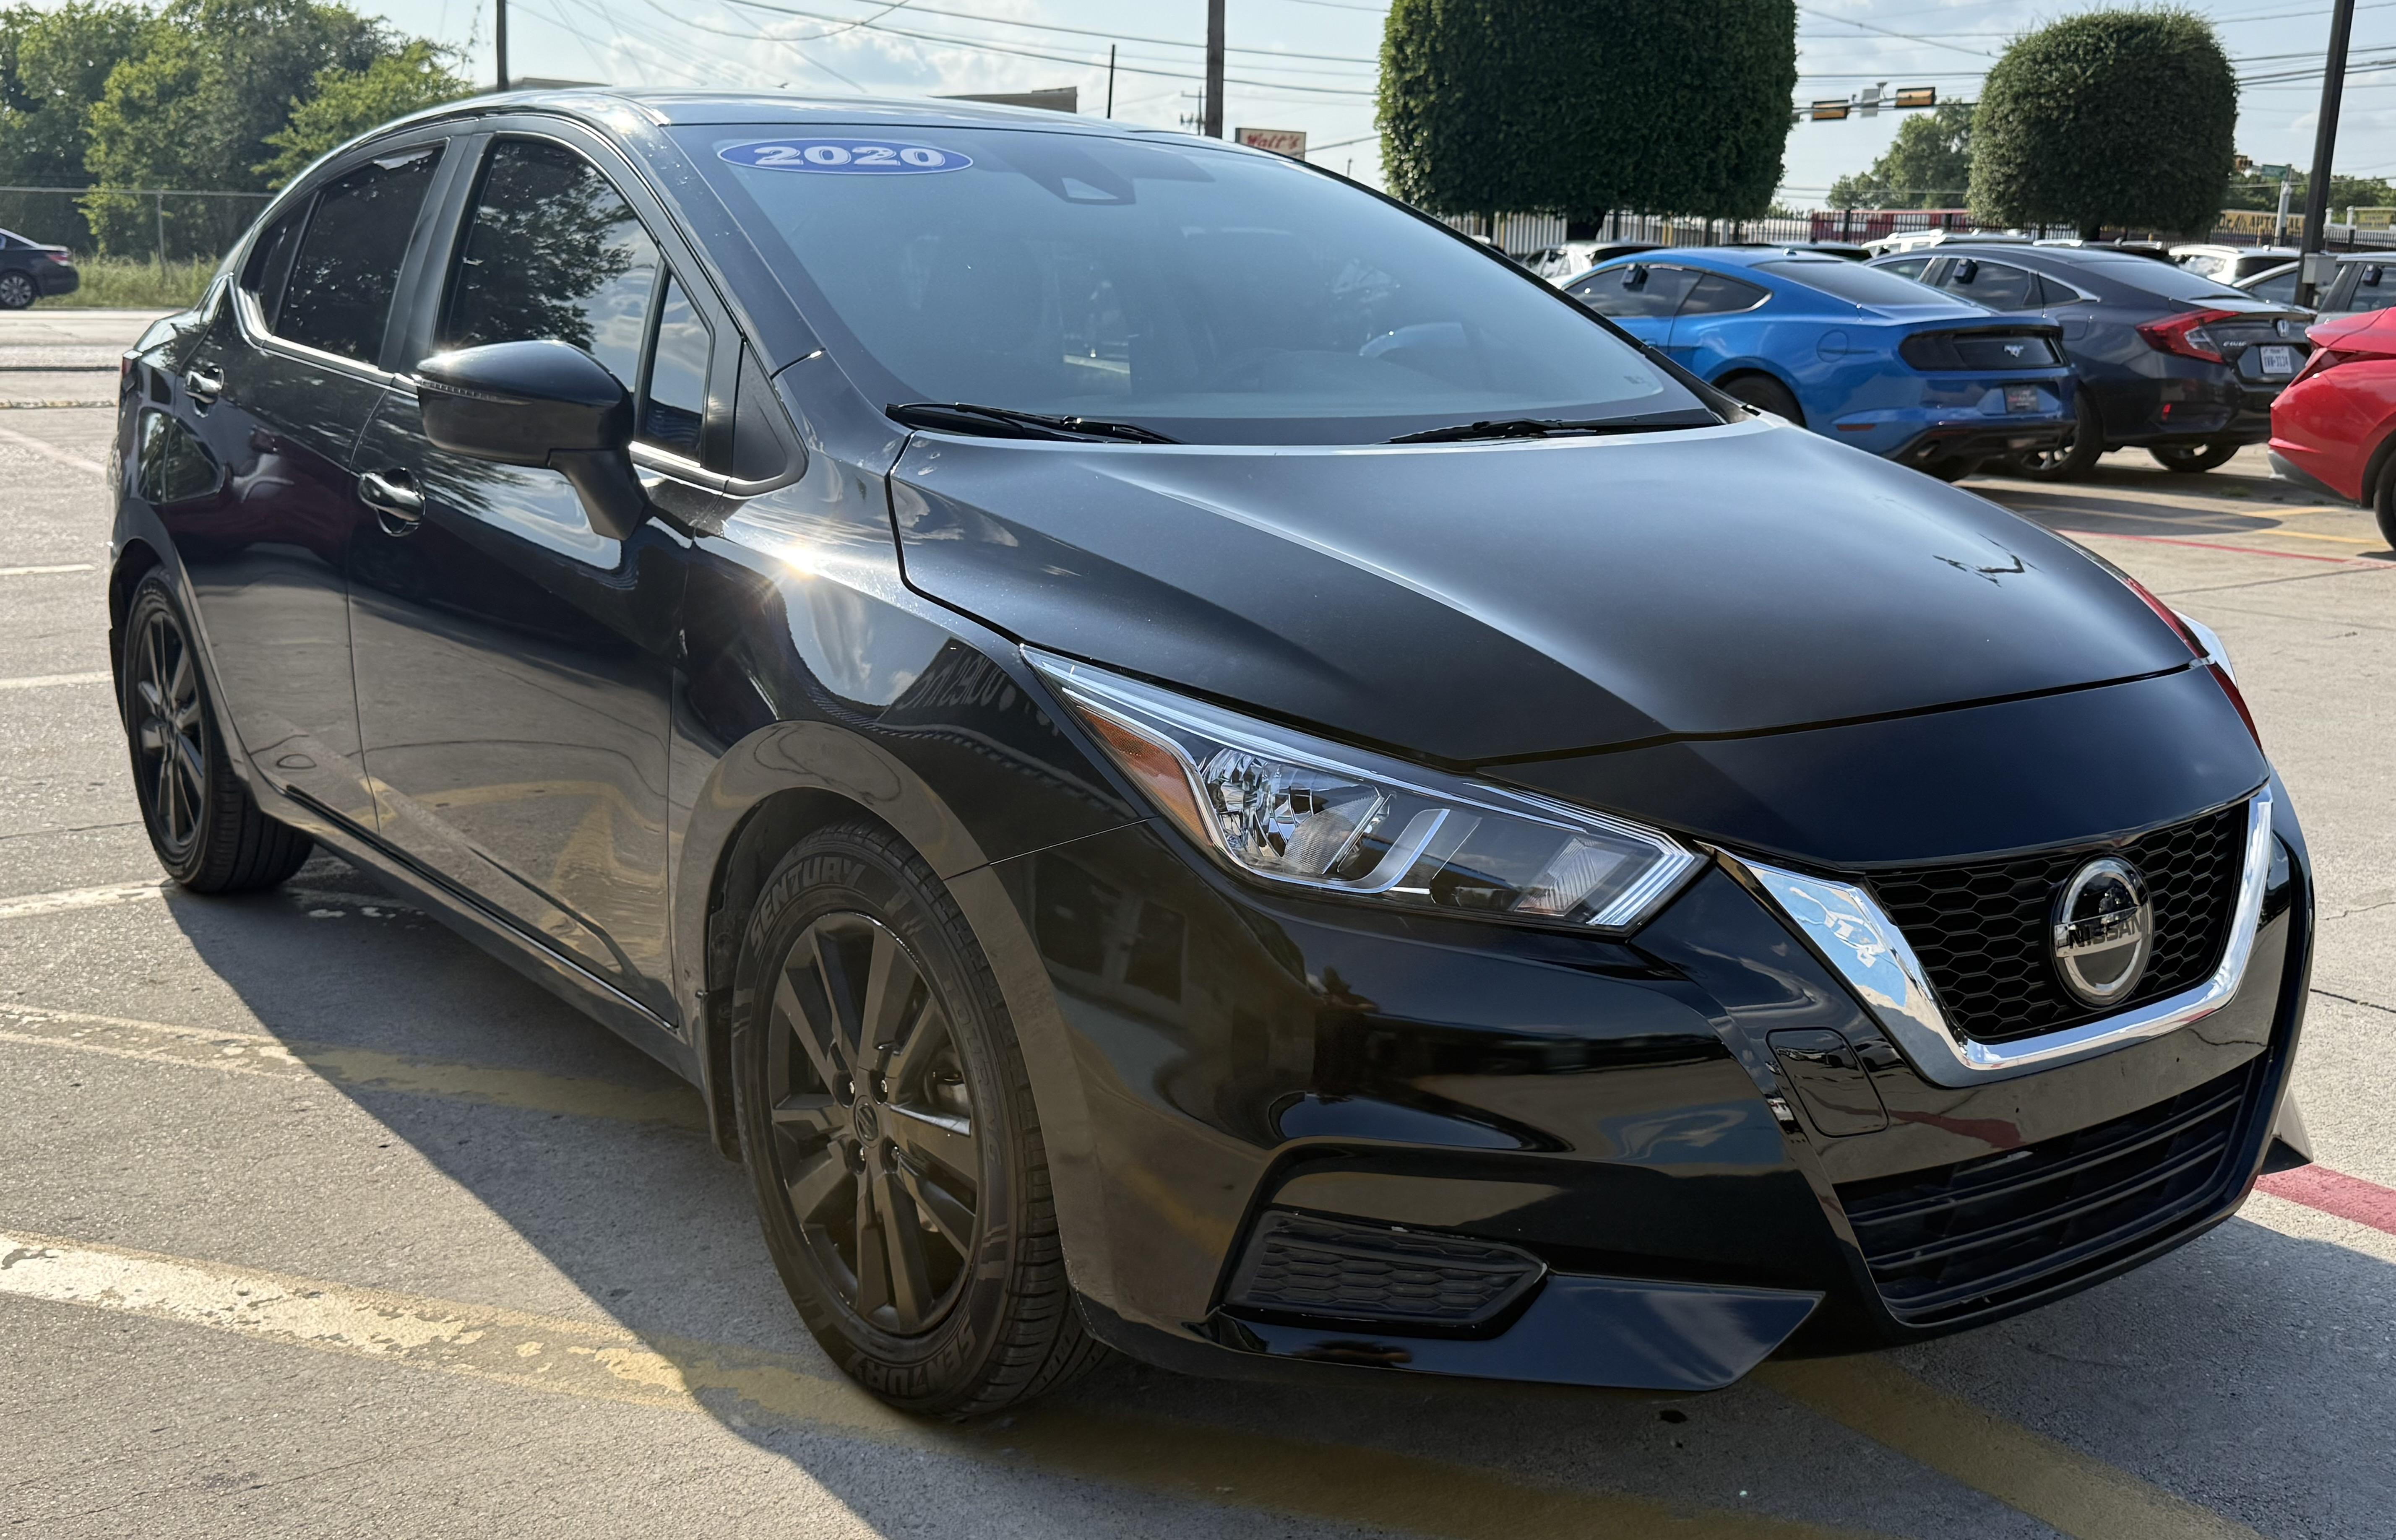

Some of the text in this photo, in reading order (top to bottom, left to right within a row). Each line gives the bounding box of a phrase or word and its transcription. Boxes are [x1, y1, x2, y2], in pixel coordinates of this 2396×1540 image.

[755, 146, 945, 166] 2020
[750, 856, 866, 960] SENTURY
[2068, 917, 2141, 949] NISSAN
